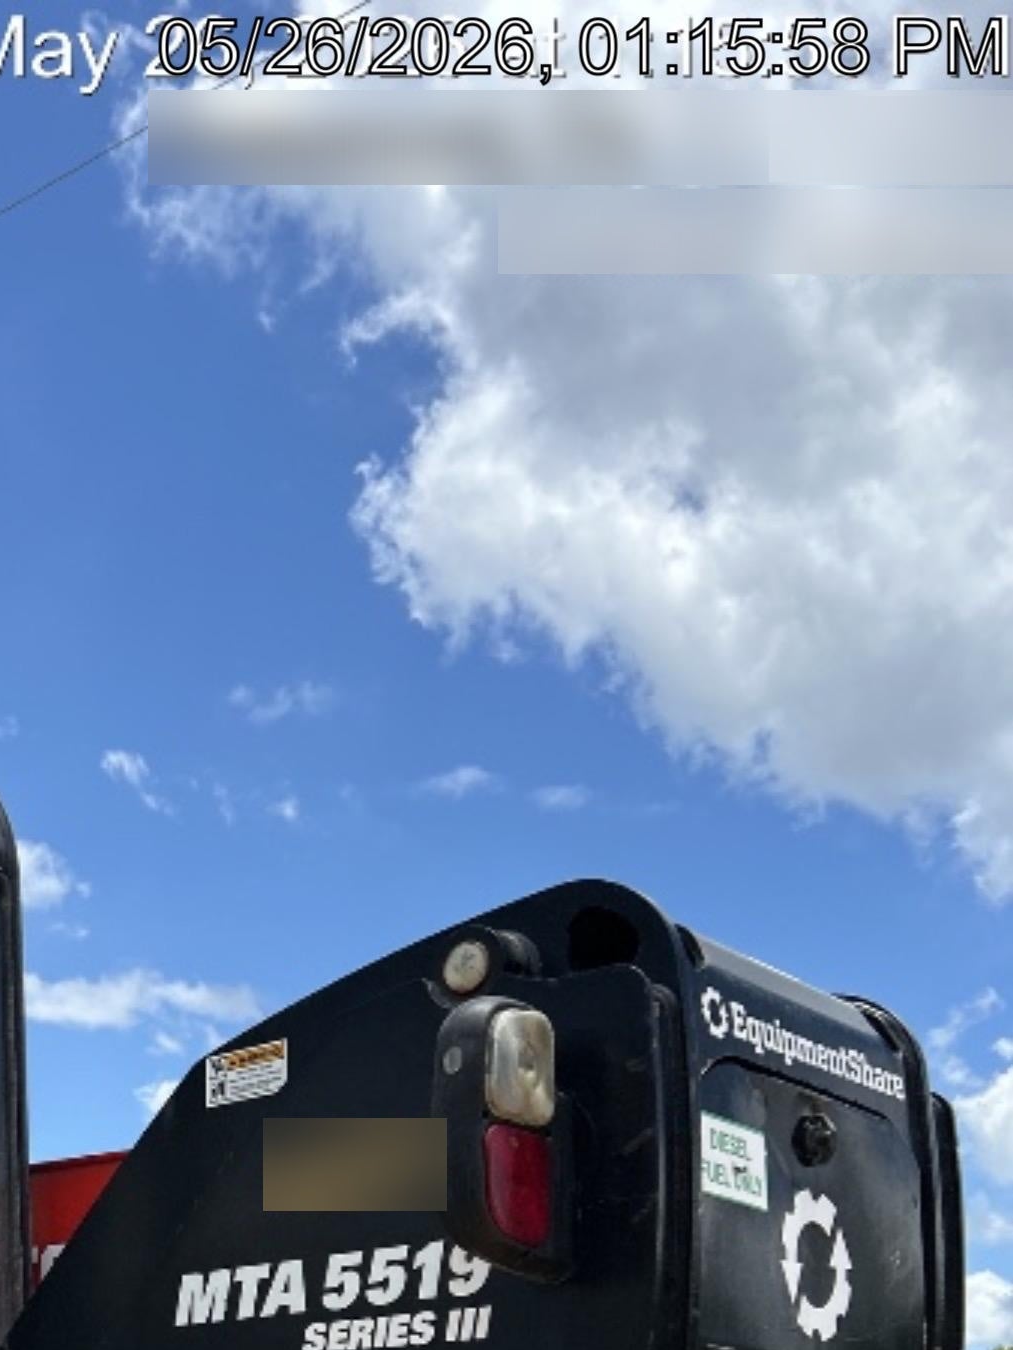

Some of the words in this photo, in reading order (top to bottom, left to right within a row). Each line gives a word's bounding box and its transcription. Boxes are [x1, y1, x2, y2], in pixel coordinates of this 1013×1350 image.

[730, 1000, 906, 1101] EquipmentShare
[709, 1127, 752, 1161] DIESEL
[701, 1159, 731, 1188] FUEL
[175, 1258, 307, 1327] MTA
[321, 1239, 493, 1312] 5519
[444, 1304, 493, 1343] III
